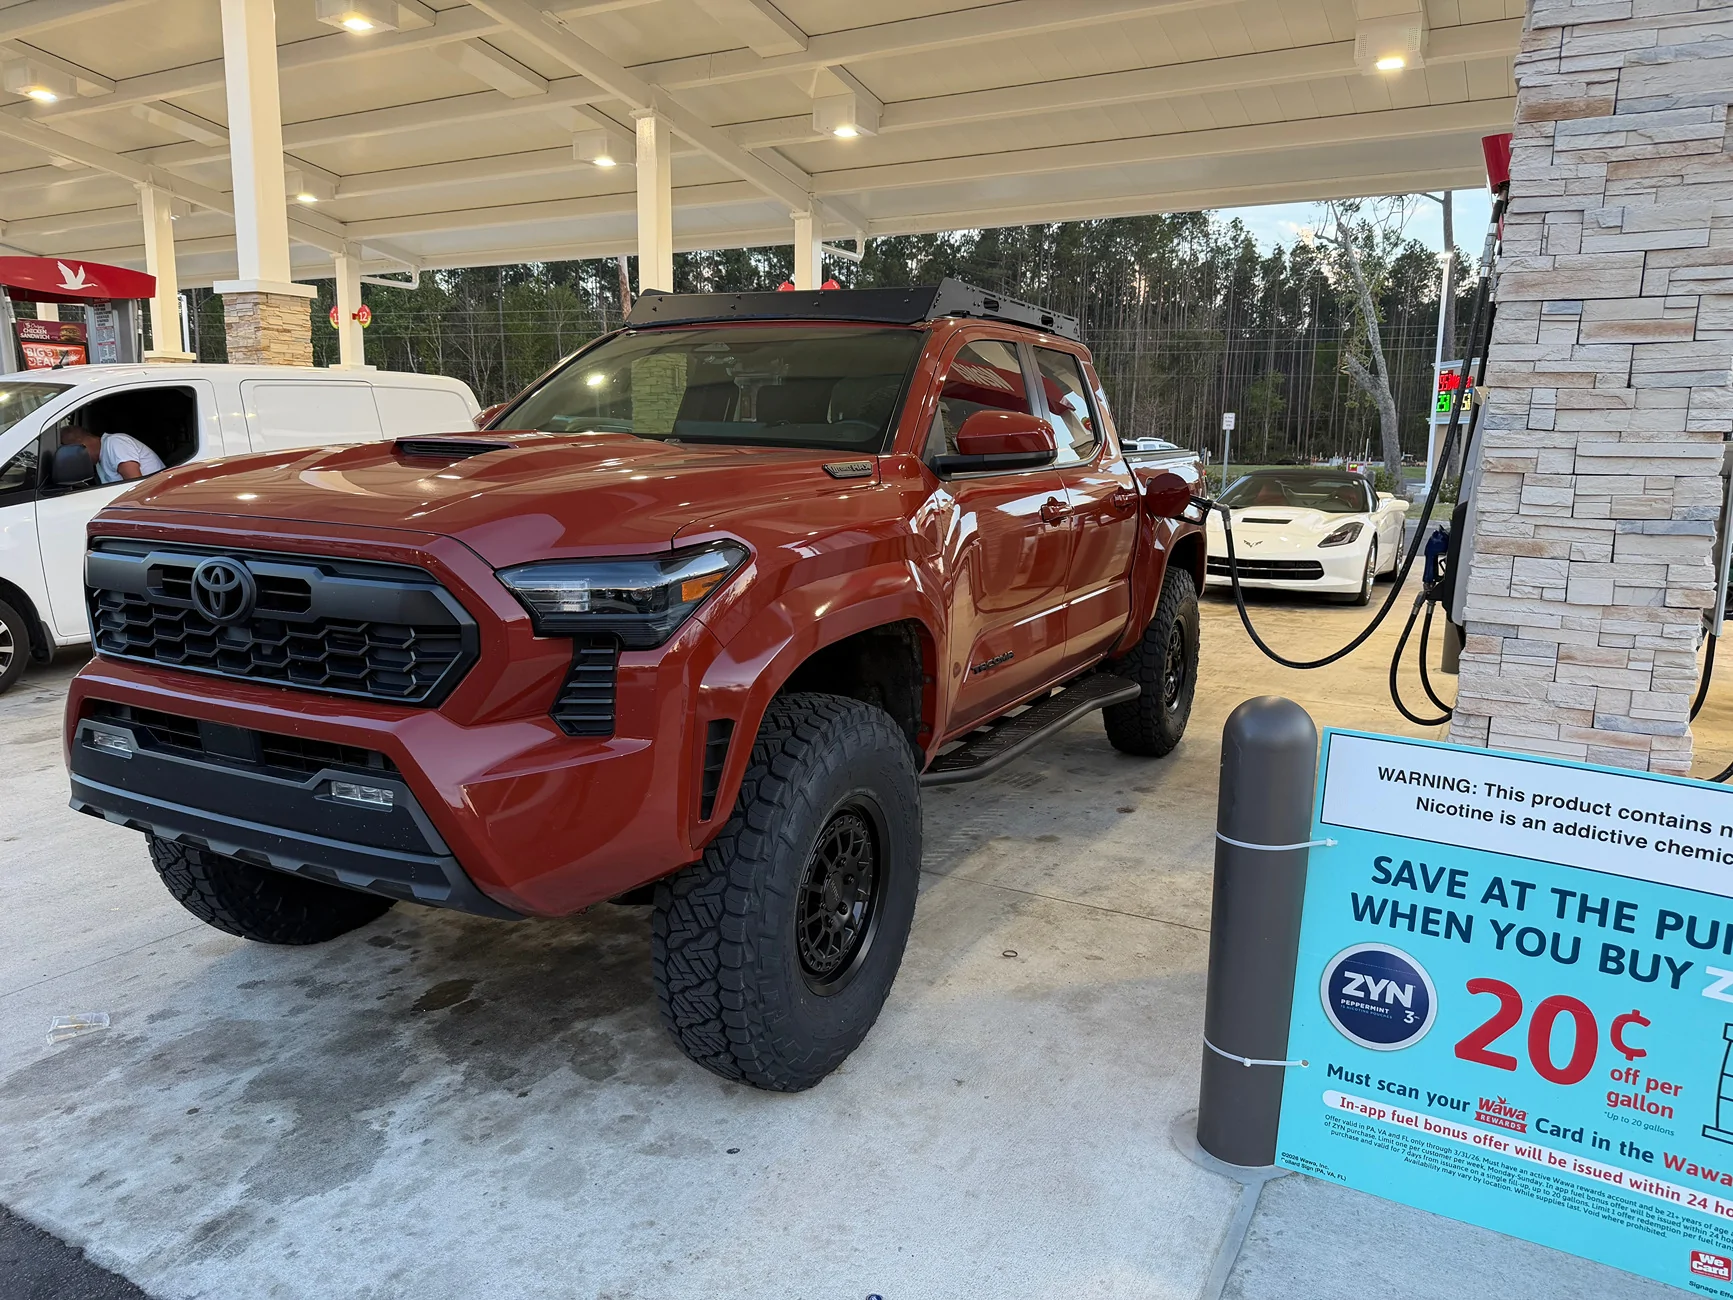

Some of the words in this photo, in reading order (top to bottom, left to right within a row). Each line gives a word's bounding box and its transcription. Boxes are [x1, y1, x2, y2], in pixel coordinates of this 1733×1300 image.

[359, 311, 368, 322] 12
[1377, 766, 1477, 794] WARNING:
[1483, 782, 1525, 802] This
[1531, 793, 1611, 817] product
[1617, 807, 1712, 834] contains
[1416, 796, 1493, 822] Nicotine
[1499, 809, 1516, 825] is
[1522, 817, 1546, 831] an
[1552, 822, 1647, 848] addictive
[1654, 838, 1733, 868] chemic
[1371, 855, 1469, 899] SAVE
[1480, 876, 1536, 911] AT
[1550, 887, 1638, 934] THE
[1655, 908, 1733, 959] PU
[1350, 892, 1473, 943] WHEN
[1489, 918, 1581, 964] YOU
[1598, 942, 1694, 989] BUY
[1340, 999, 1390, 1014] PEPPERMINT
[1342, 971, 1414, 1009] ZYN
[1610, 1067, 1640, 1085] off
[1645, 1077, 1683, 1096] per
[1606, 1090, 1673, 1119] gallon
[1326, 1063, 1370, 1087] Must
[1376, 1079, 1419, 1100] scan
[1426, 1091, 1470, 1112] your
[1479, 1097, 1527, 1122] Wawa
[1535, 1117, 1584, 1143] Card
[1591, 1130, 1610, 1151] in
[1619, 1141, 1654, 1163] the
[1663, 1151, 1733, 1187] Wawa
[1480, 1114, 1522, 1130] REWARDS
[1620, 1116, 1630, 1124] to
[1631, 1118, 1643, 1127] 20
[1643, 1123, 1675, 1137] gallons
[1300, 1156, 1318, 1167] Wawa,
[1319, 1162, 1330, 1170] Inc.
[1339, 1096, 1385, 1120] In-app
[1391, 1109, 1418, 1127] fuel
[1423, 1118, 1467, 1140] bonus
[1473, 1134, 1509, 1151] offer
[1514, 1145, 1541, 1161] will
[1547, 1151, 1566, 1168] be
[1573, 1158, 1623, 1184] issued
[1629, 1178, 1680, 1201] within
[1686, 1193, 1707, 1209] 24
[1301, 1163, 1314, 1171] Sign
[1315, 1167, 1326, 1176] (PA,
[1327, 1170, 1336, 1179] VA,
[1337, 1174, 1347, 1182] FL)
[1325, 1113, 1341, 1122] Offer
[1342, 1119, 1357, 1127] valid
[1366, 1125, 1376, 1133] PA,
[1410, 1138, 1424, 1147] only
[1426, 1141, 1452, 1154] through
[1454, 1149, 1480, 1162] 3/31/26.
[1482, 1157, 1499, 1167] Must
[1500, 1162, 1517, 1172] have
[1529, 1171, 1550, 1181] active
[1552, 1177, 1574, 1188] Wawa
[1576, 1184, 1605, 1197] rewards
[1607, 1193, 1636, 1206] account
[1638, 1203, 1653, 1211] and
[1655, 1206, 1664, 1215] be
[1666, 1210, 1679, 1219] 21+
[1681, 1216, 1701, 1226] years
[1704, 1222, 1712, 1230] of
[1713, 1225, 1728, 1235] age
[1330, 1129, 1359, 1141] purchase
[1373, 1141, 1389, 1150] valid
[1390, 1145, 1399, 1153] for
[1406, 1150, 1421, 1159] days
[1423, 1154, 1438, 1164] from
[1440, 1159, 1468, 1172] issuance
[1486, 1173, 1506, 1183] single
[1508, 1179, 1530, 1191] fill-up,
[1532, 1186, 1541, 1195] up
[1543, 1188, 1550, 1196] to
[1551, 1191, 1560, 1199] 20
[1562, 1195, 1589, 1207] gallons.
[1592, 1202, 1610, 1213] Limit
[1616, 1211, 1634, 1221] offer
[1637, 1217, 1681, 1235] redemption
[1683, 1231, 1696, 1240] per
[1698, 1235, 1713, 1245] fuel
[1331, 1122, 1345, 1130] ZYN
[1346, 1127, 1376, 1139] purchase.
[1378, 1135, 1393, 1144] Limit
[1421, 1148, 1451, 1160] customer
[1466, 1161, 1485, 1171] week,
[1487, 1165, 1543, 1187] Monday-Sunday.
[1554, 1186, 1568, 1195] app
[1570, 1189, 1584, 1198] fuel
[1586, 1193, 1608, 1205] bonus
[1610, 1201, 1628, 1211] offer
[1630, 1207, 1643, 1216] will
[1645, 1211, 1655, 1219] be
[1657, 1215, 1681, 1227] issued
[1683, 1224, 1707, 1236] within
[1709, 1230, 1718, 1239] 24
[1403, 1156, 1440, 1173] Availability
[1441, 1168, 1456, 1177] may
[1457, 1172, 1471, 1182] vary
[1473, 1176, 1481, 1185] by
[1482, 1178, 1512, 1192] location.
[1514, 1187, 1534, 1198] While
[1536, 1195, 1564, 1207] supplies
[1566, 1202, 1581, 1212] last.
[1583, 1207, 1599, 1217] Void
[1601, 1214, 1624, 1225] where
[1626, 1221, 1666, 1238] prohibited.
[1692, 1260, 1729, 1277] Card
[1698, 1253, 1724, 1267] We
[1688, 1280, 1718, 1294] Signage
